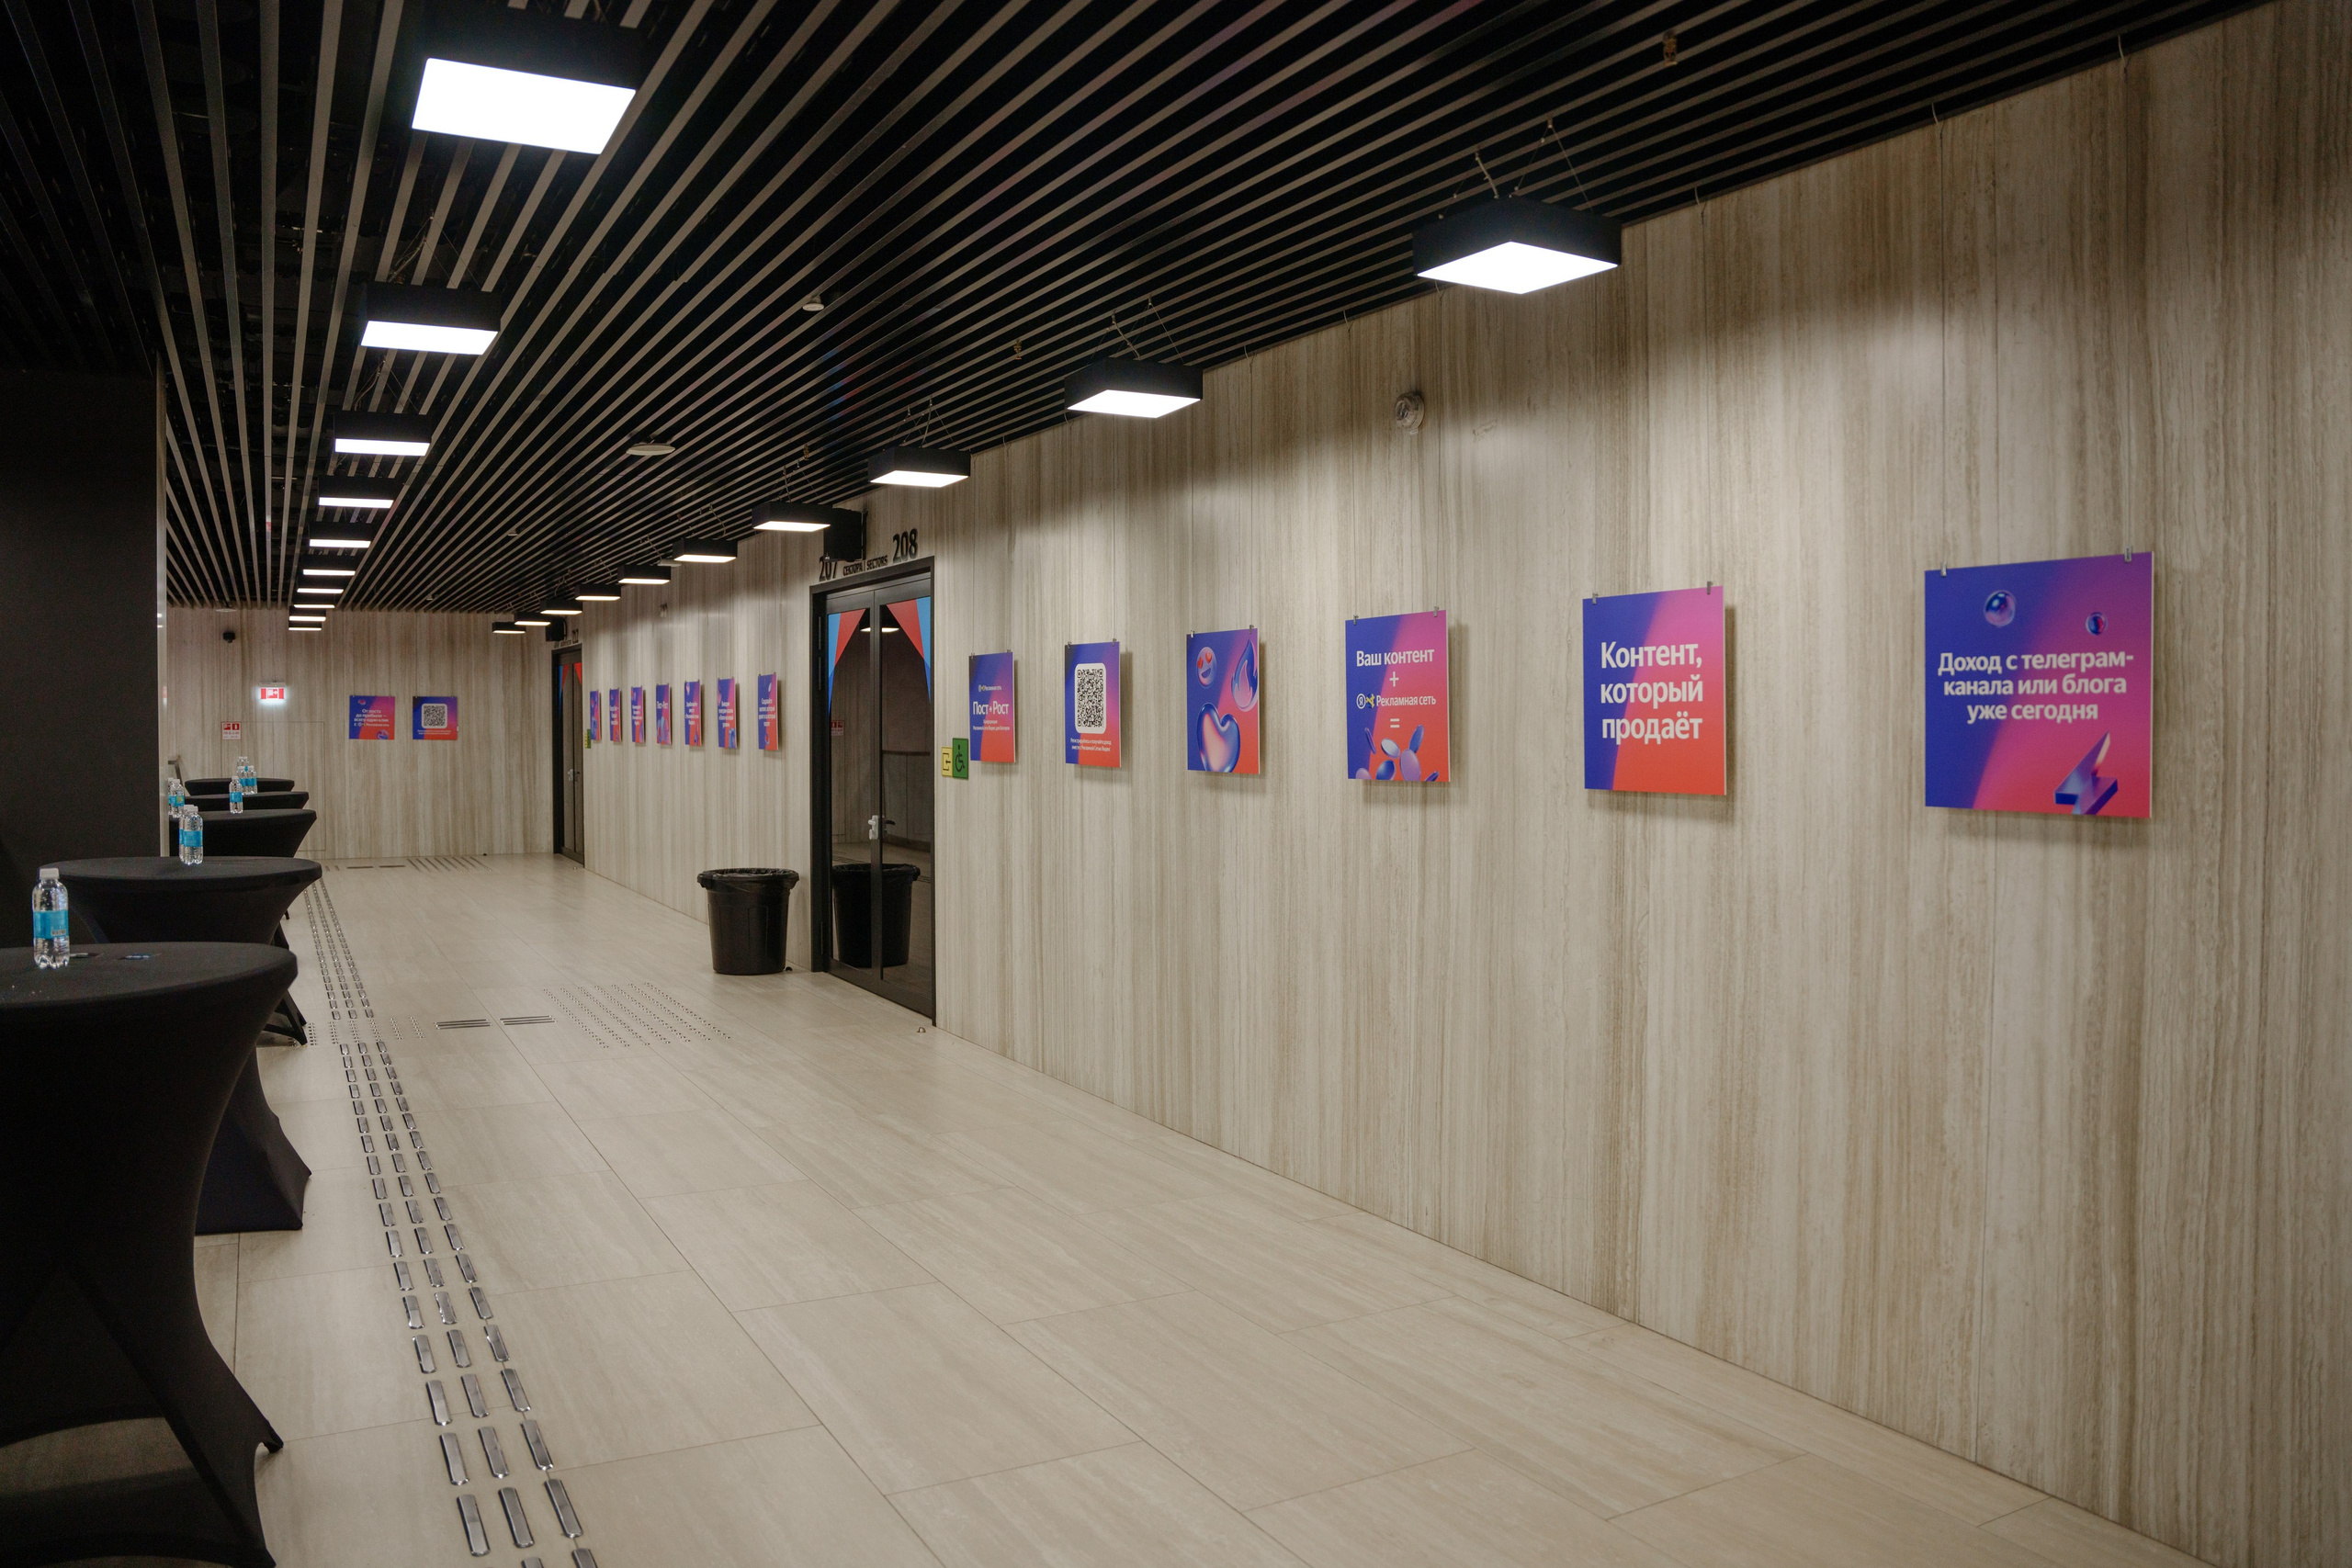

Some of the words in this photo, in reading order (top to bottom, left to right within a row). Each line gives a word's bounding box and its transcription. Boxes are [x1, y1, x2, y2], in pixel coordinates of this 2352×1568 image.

[866, 555, 888, 570] SECTORS
[893, 528, 918, 563] 208
[1356, 650, 1382, 667] Ваш
[1385, 649, 1435, 665] контент
[1600, 641, 1702, 669] Контент,
[1938, 652, 2003, 676] Доход
[2006, 655, 2018, 670] с
[2021, 651, 2134, 673] телеграм-
[1600, 673, 1703, 709] который
[1943, 680, 2013, 696] канала
[2018, 679, 2058, 694] или
[2062, 673, 2127, 694] блога
[973, 701, 989, 716] Пост
[992, 701, 1010, 715] Рост
[1376, 695, 1418, 706] Рекламная
[1419, 695, 1437, 705] сеть
[1967, 705, 2007, 725] уже
[2011, 704, 2098, 724] сегодня
[1602, 710, 1702, 745] продаёт
